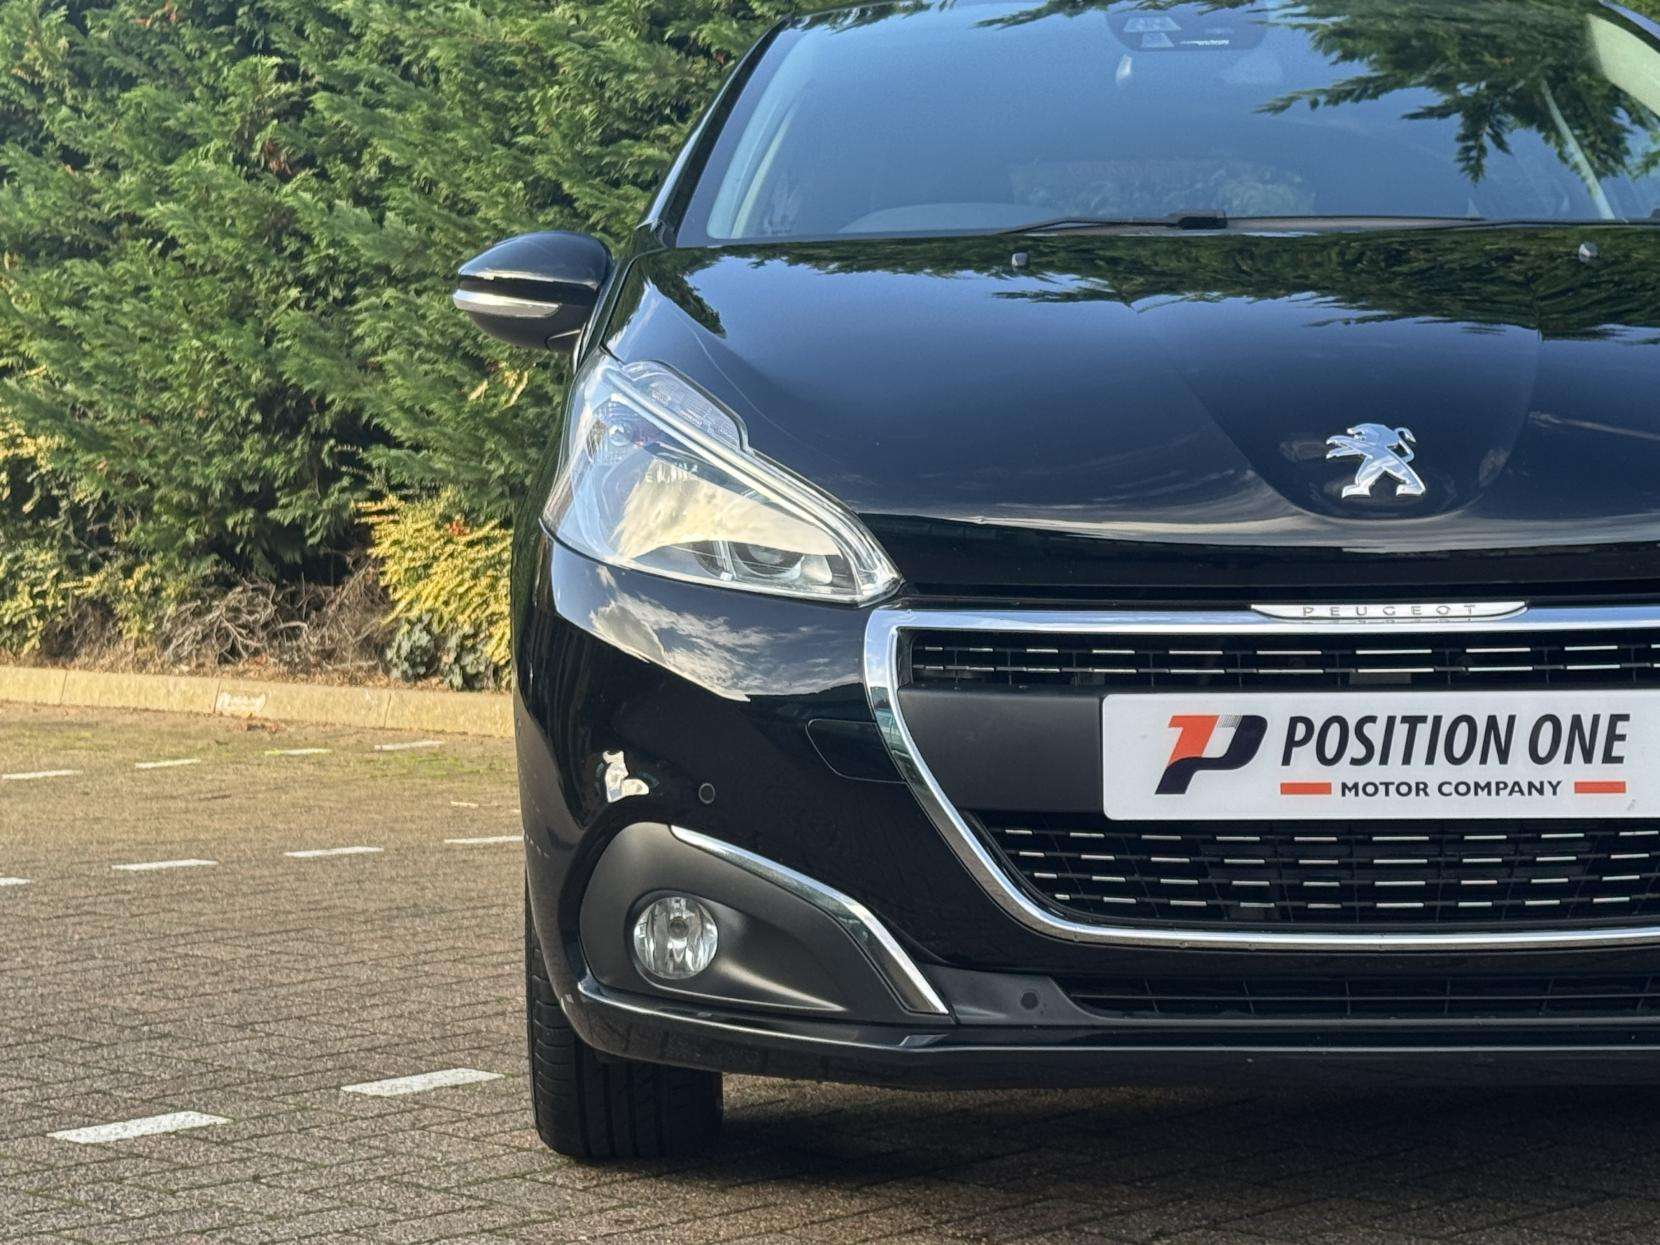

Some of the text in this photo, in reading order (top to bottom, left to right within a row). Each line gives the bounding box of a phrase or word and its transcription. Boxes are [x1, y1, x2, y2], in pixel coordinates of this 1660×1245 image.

[1302, 604, 1476, 618] PEUGEOT
[1281, 713, 1631, 766] POSITION ONE
[1340, 780, 1563, 798] MOTOR COMPANY
